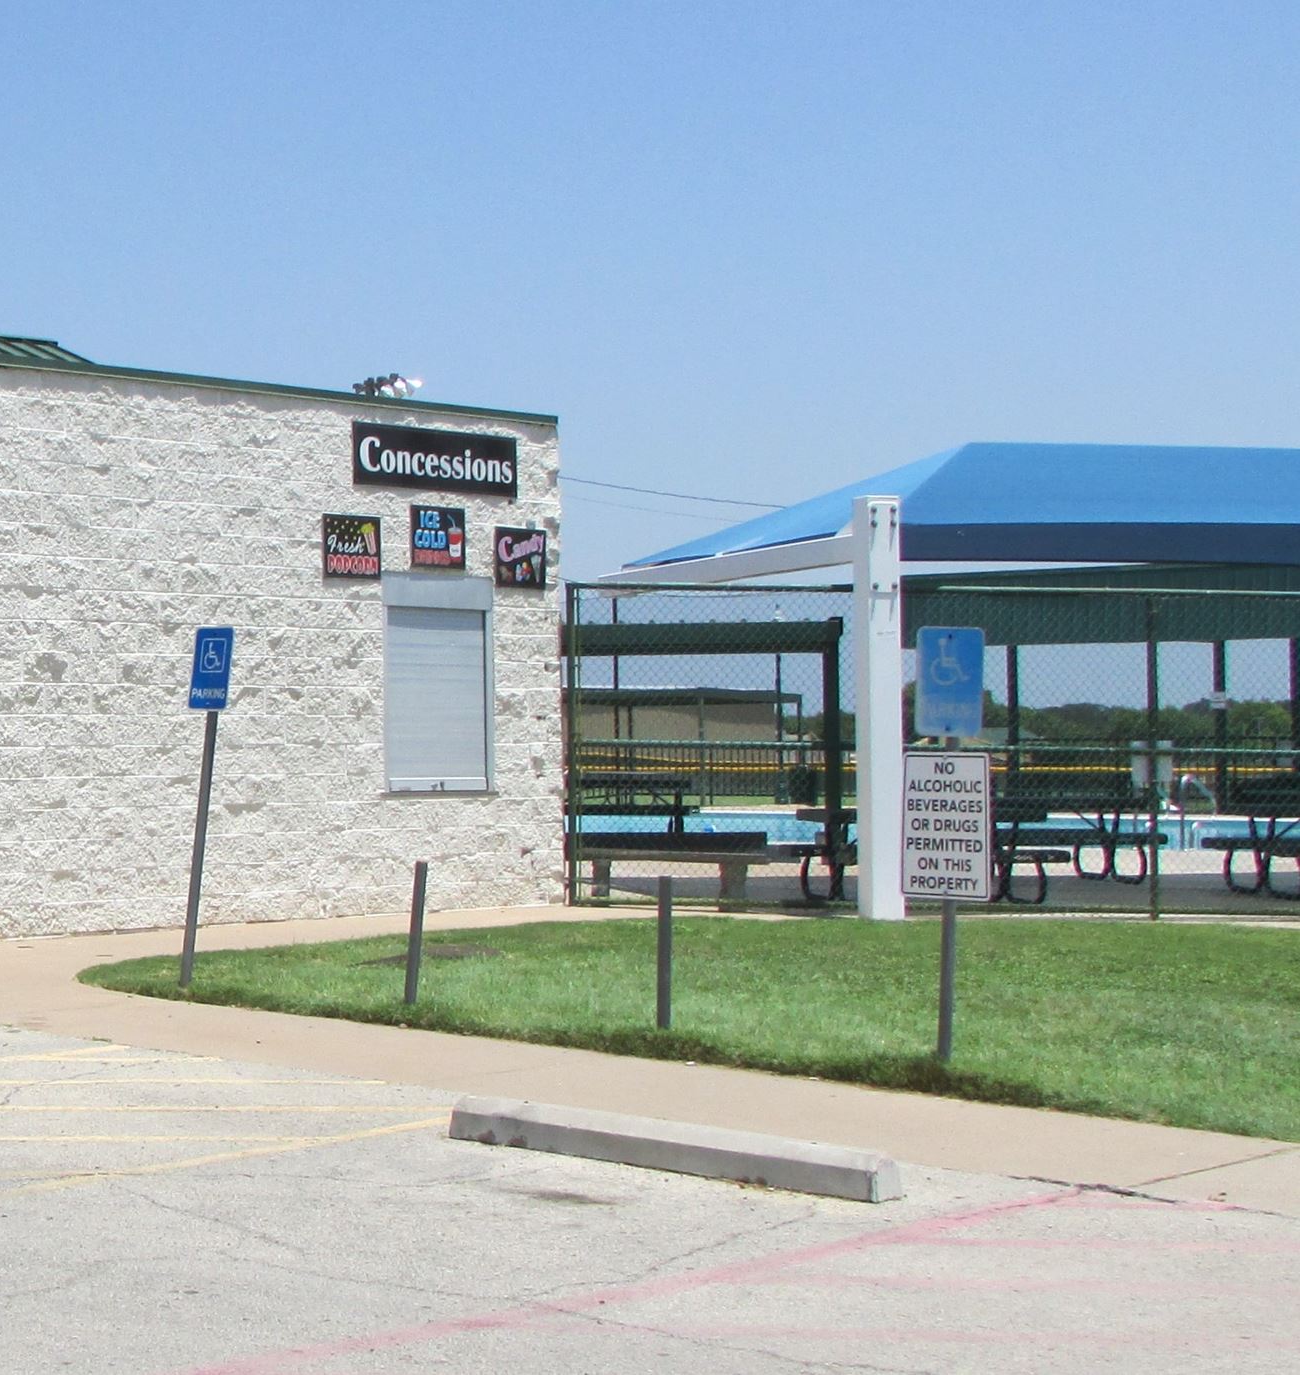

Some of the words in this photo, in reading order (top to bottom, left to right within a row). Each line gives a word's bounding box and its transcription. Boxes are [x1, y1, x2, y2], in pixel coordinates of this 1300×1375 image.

[359, 436, 513, 484] Concessions
[419, 510, 440, 529] ICE
[327, 534, 364, 554] Fresh
[414, 529, 447, 549] COLD
[498, 533, 544, 562] Candy
[327, 554, 378, 575] POPCORN
[191, 688, 225, 699] PARKING
[934, 762, 955, 775] NO
[908, 779, 982, 794] ALCOHOLIC
[907, 799, 983, 814] BEVERAGES
[911, 818, 929, 831] OR
[933, 819, 979, 833] DRUGS
[906, 837, 983, 853] PERMITTED
[918, 857, 939, 871] ON
[943, 858, 972, 873] THIS
[910, 876, 978, 891] PROPERTY
